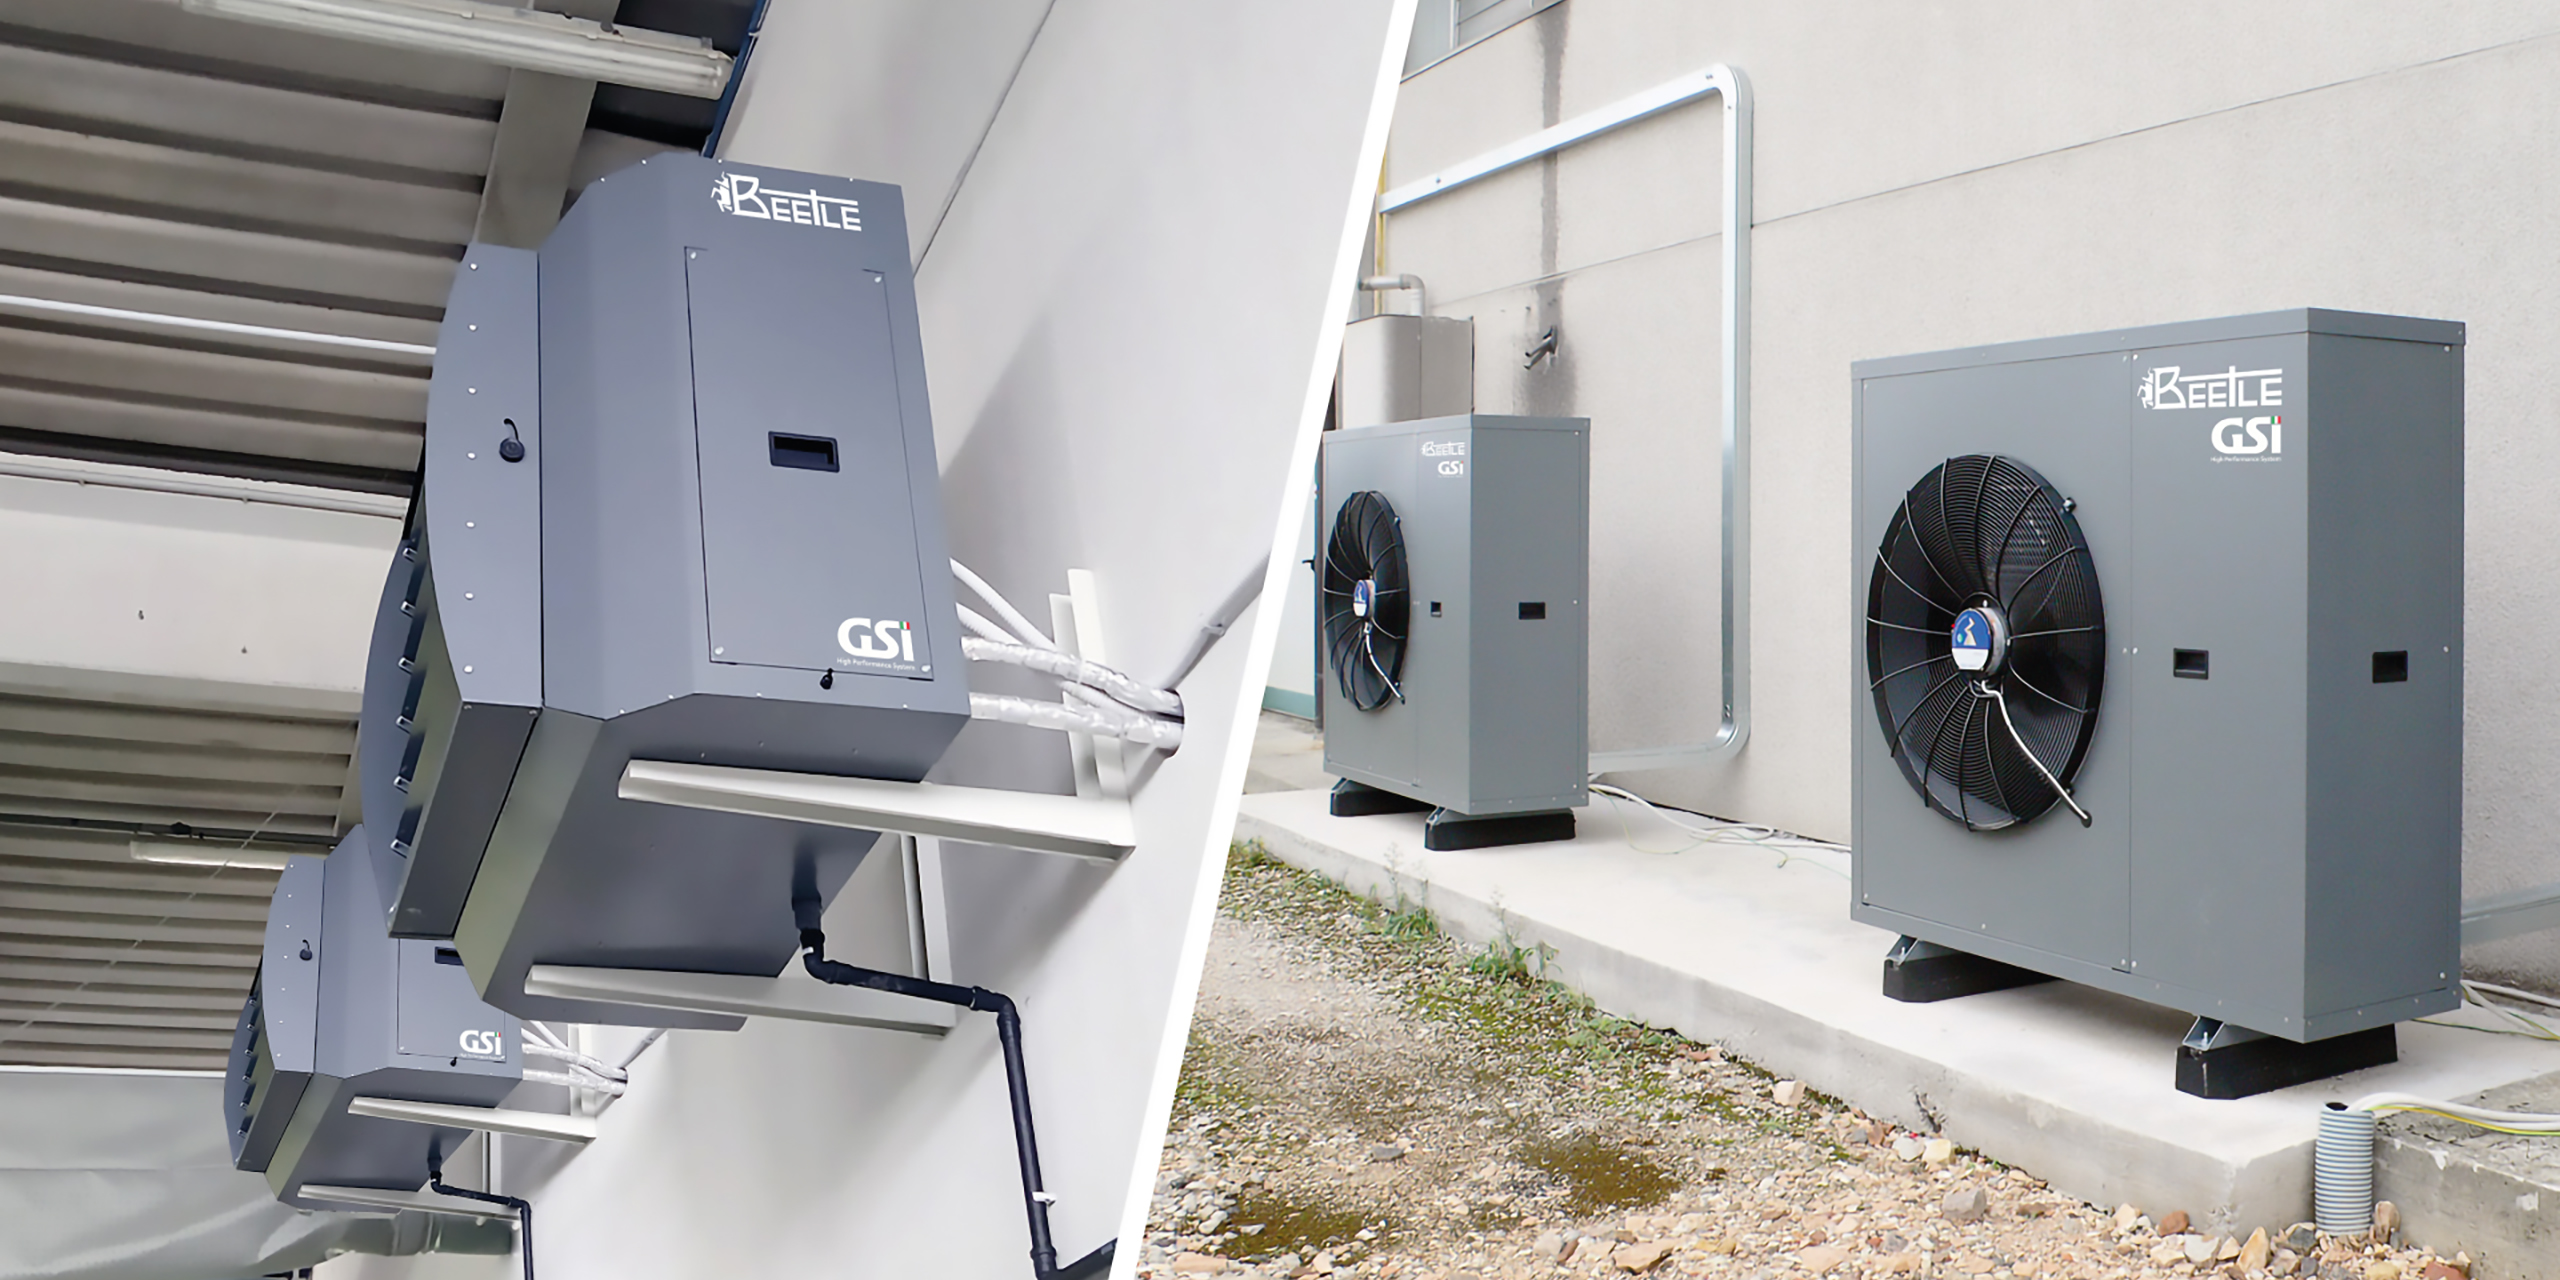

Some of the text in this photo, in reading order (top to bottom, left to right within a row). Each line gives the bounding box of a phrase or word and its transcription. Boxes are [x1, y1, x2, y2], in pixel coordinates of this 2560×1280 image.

[727, 173, 862, 232] BEETLE
[2152, 365, 2283, 410] BEETLE
[2210, 456, 2222, 464] High
[836, 657, 916, 672] High Performance System
